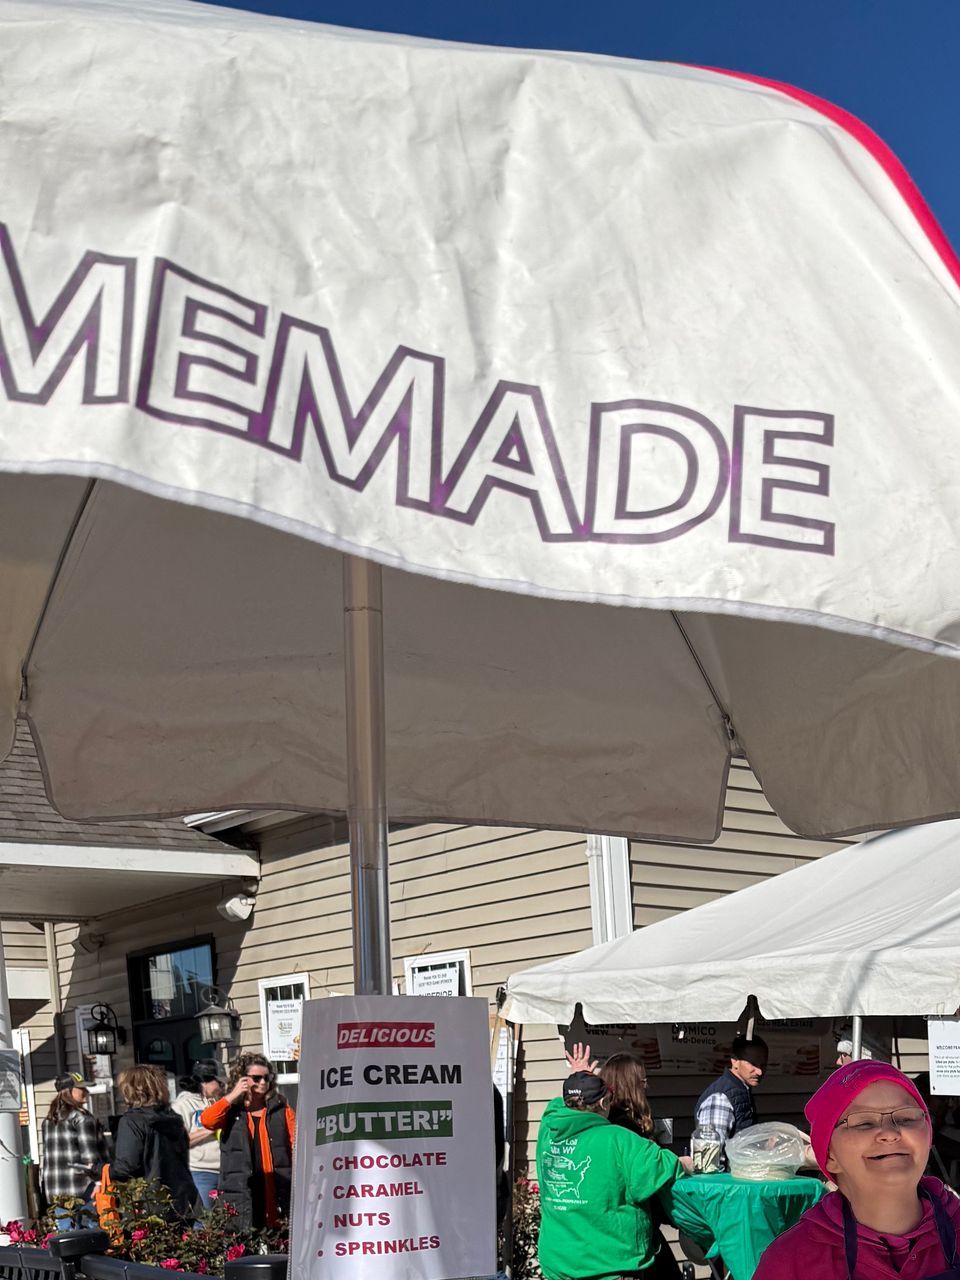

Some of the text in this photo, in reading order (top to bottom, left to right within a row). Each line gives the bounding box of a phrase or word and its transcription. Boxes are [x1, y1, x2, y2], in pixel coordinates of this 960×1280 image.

[337, 1027, 436, 1045] DELICIOUS
[320, 1064, 462, 1090] ICE CREAM
[332, 1152, 447, 1172] CHOCOLATE
[333, 1181, 424, 1200] CARAMEL
[333, 1212, 391, 1229] NUTS
[335, 1235, 441, 1257] SPRINKLES
